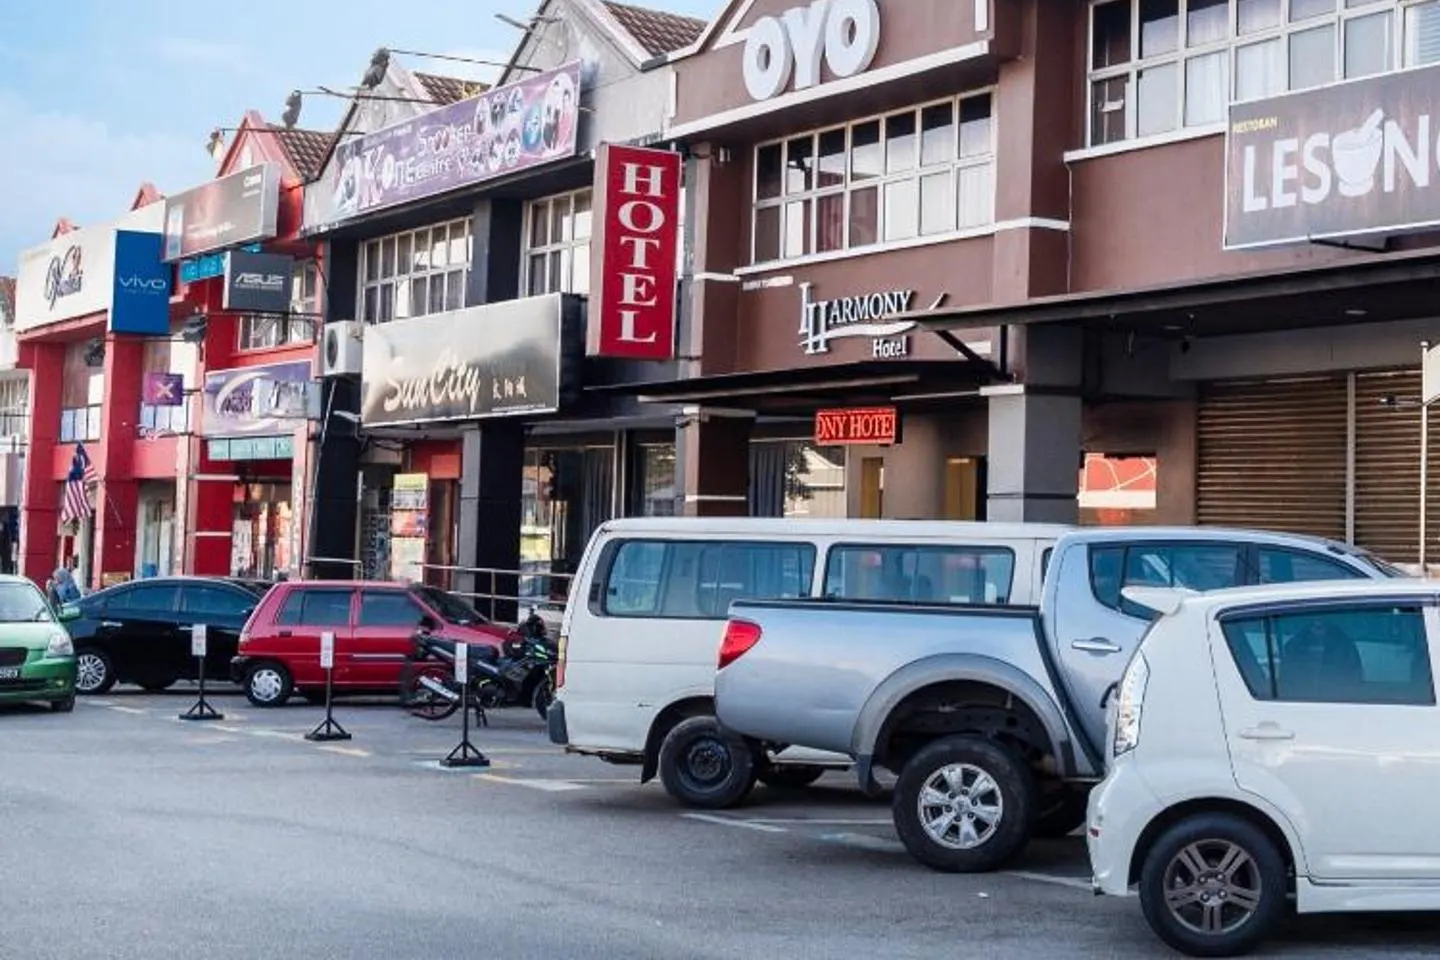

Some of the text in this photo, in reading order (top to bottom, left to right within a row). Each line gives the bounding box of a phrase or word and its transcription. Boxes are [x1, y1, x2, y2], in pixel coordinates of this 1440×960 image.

[617, 162, 666, 343] HOTEL
[119, 273, 167, 289] vivo
[235, 272, 285, 285] ASUS
[872, 335, 908, 358] Hotel
